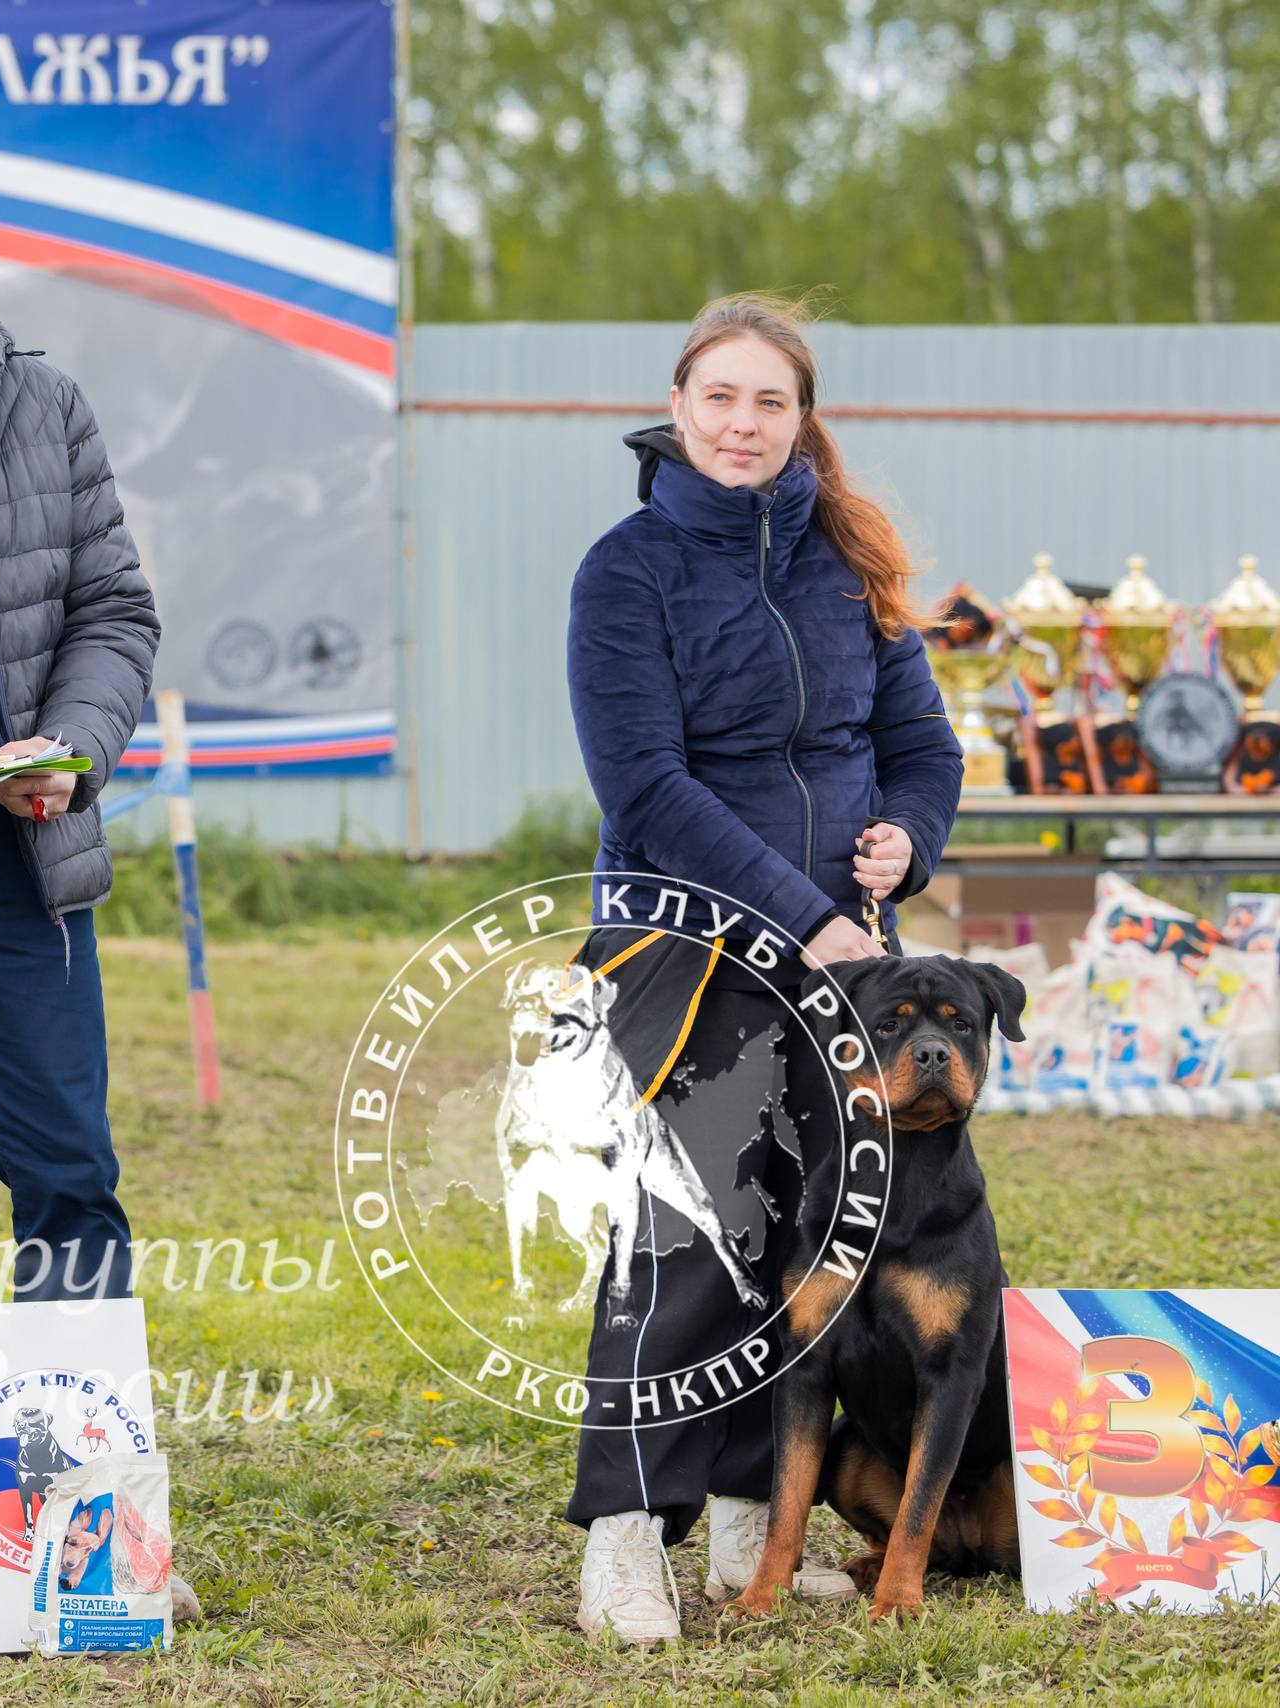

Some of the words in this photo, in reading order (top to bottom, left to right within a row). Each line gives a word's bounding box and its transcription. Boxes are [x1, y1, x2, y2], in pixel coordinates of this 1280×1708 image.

[40, 1373, 96, 1395] КЛУБ
[1082, 1335, 1207, 1498] 3
[1136, 1563, 1173, 1572] место
[71, 1598, 128, 1610] STATERA
